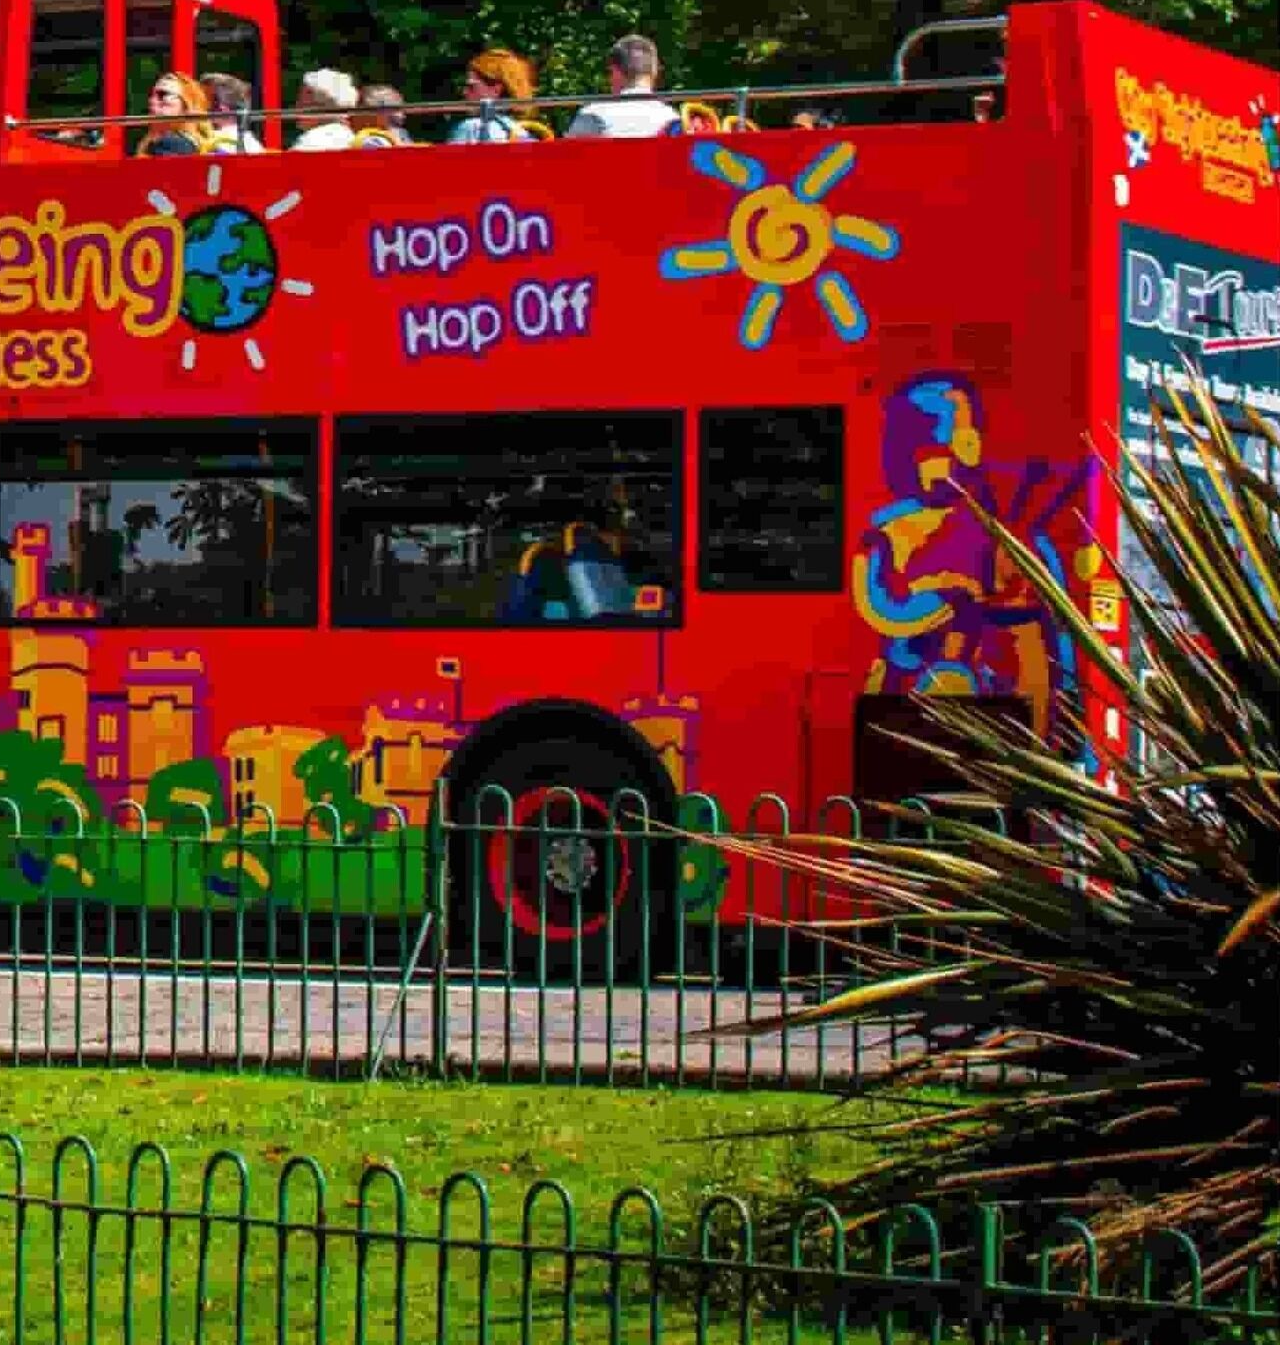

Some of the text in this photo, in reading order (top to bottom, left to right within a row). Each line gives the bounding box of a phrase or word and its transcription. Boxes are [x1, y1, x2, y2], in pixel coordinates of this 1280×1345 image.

[372, 202, 550, 273] Hop On
[404, 279, 592, 355] Hop Off
